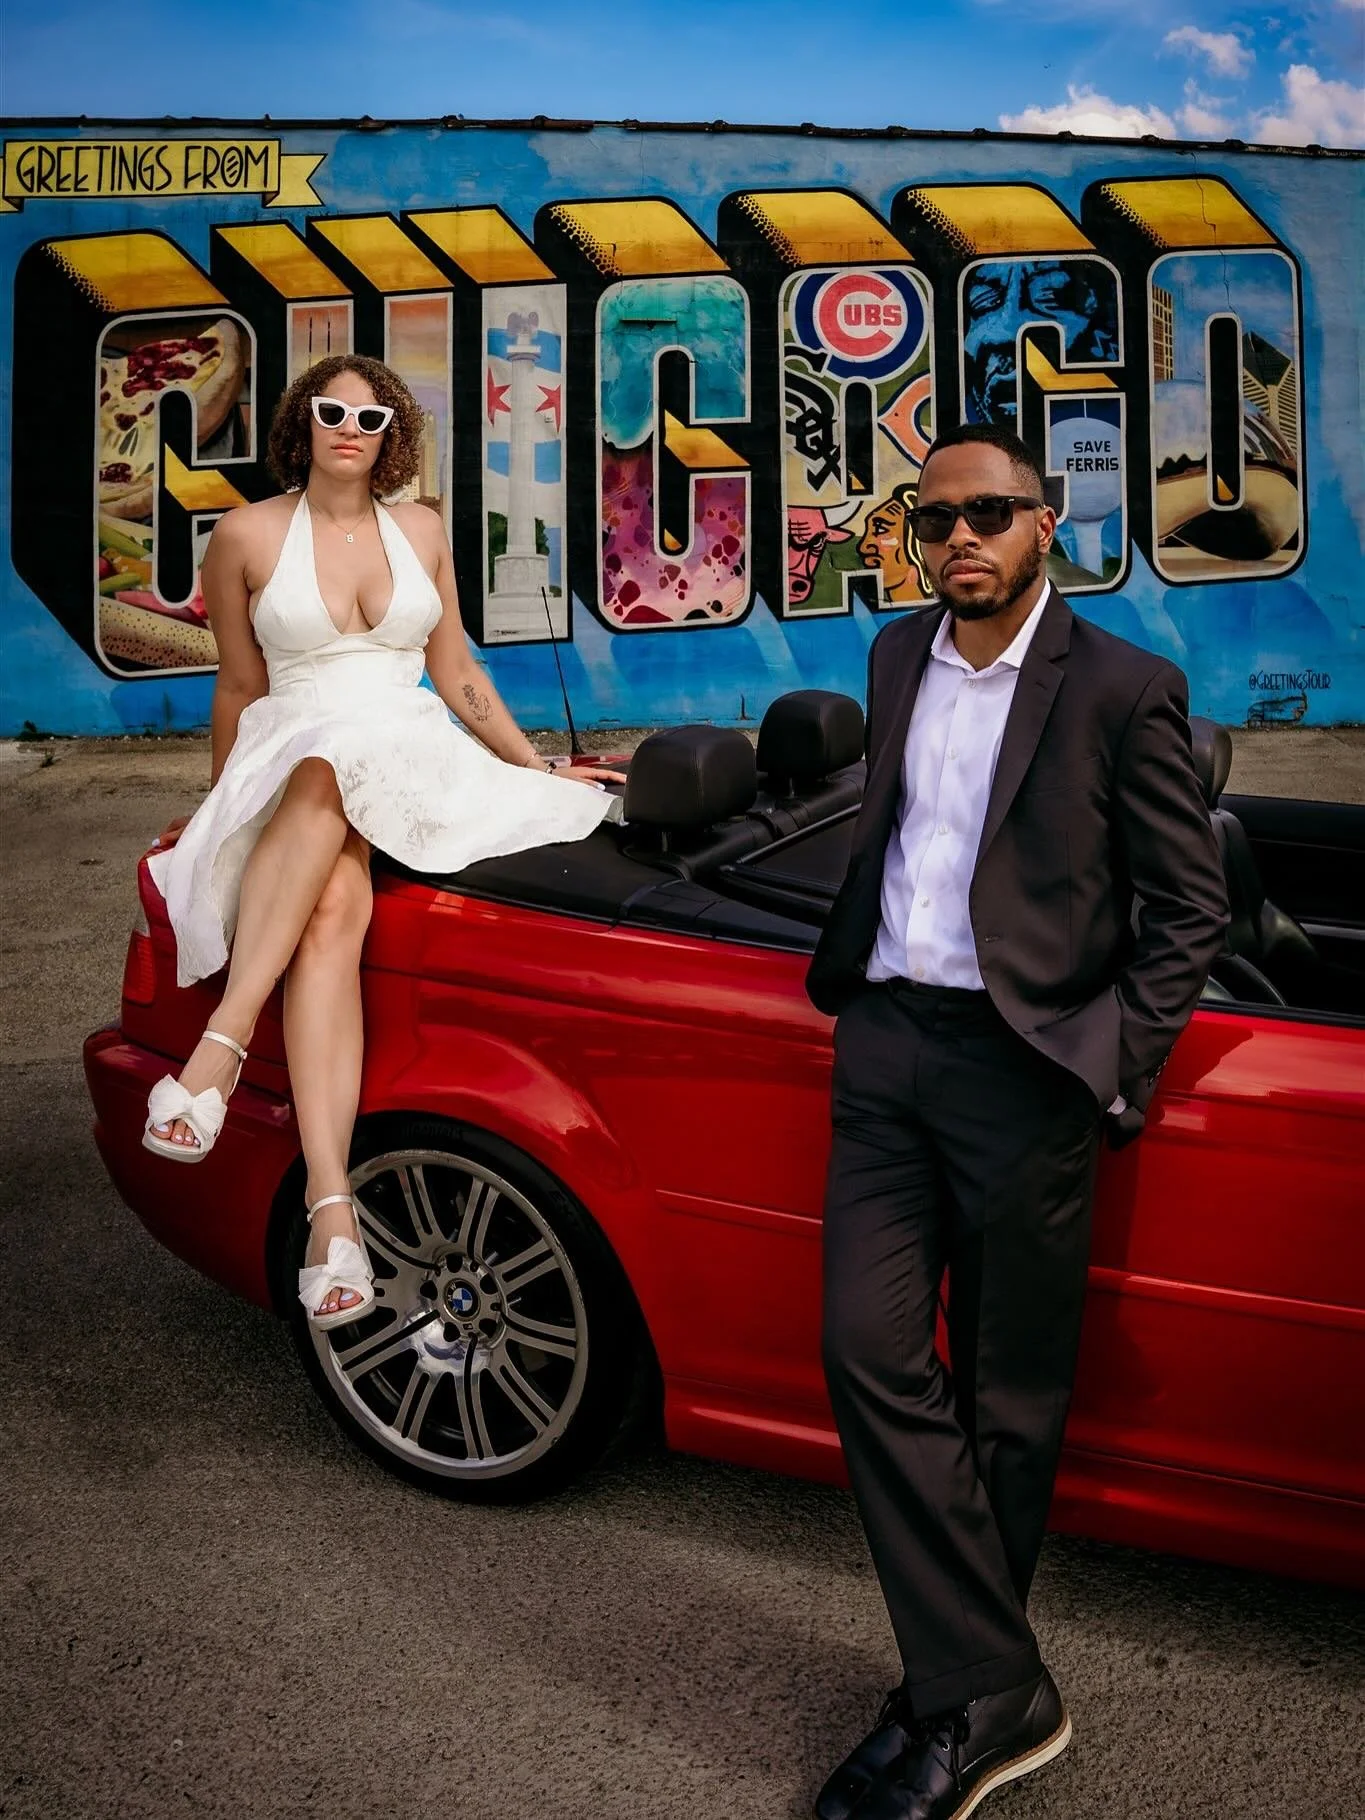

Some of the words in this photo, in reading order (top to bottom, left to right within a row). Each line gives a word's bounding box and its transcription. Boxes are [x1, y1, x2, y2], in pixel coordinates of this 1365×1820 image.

[16, 144, 172, 193] GREETINGS
[184, 144, 269, 189] FROM
[1073, 440, 1111, 453] SAVE
[1066, 457, 1119, 472] FERRIS
